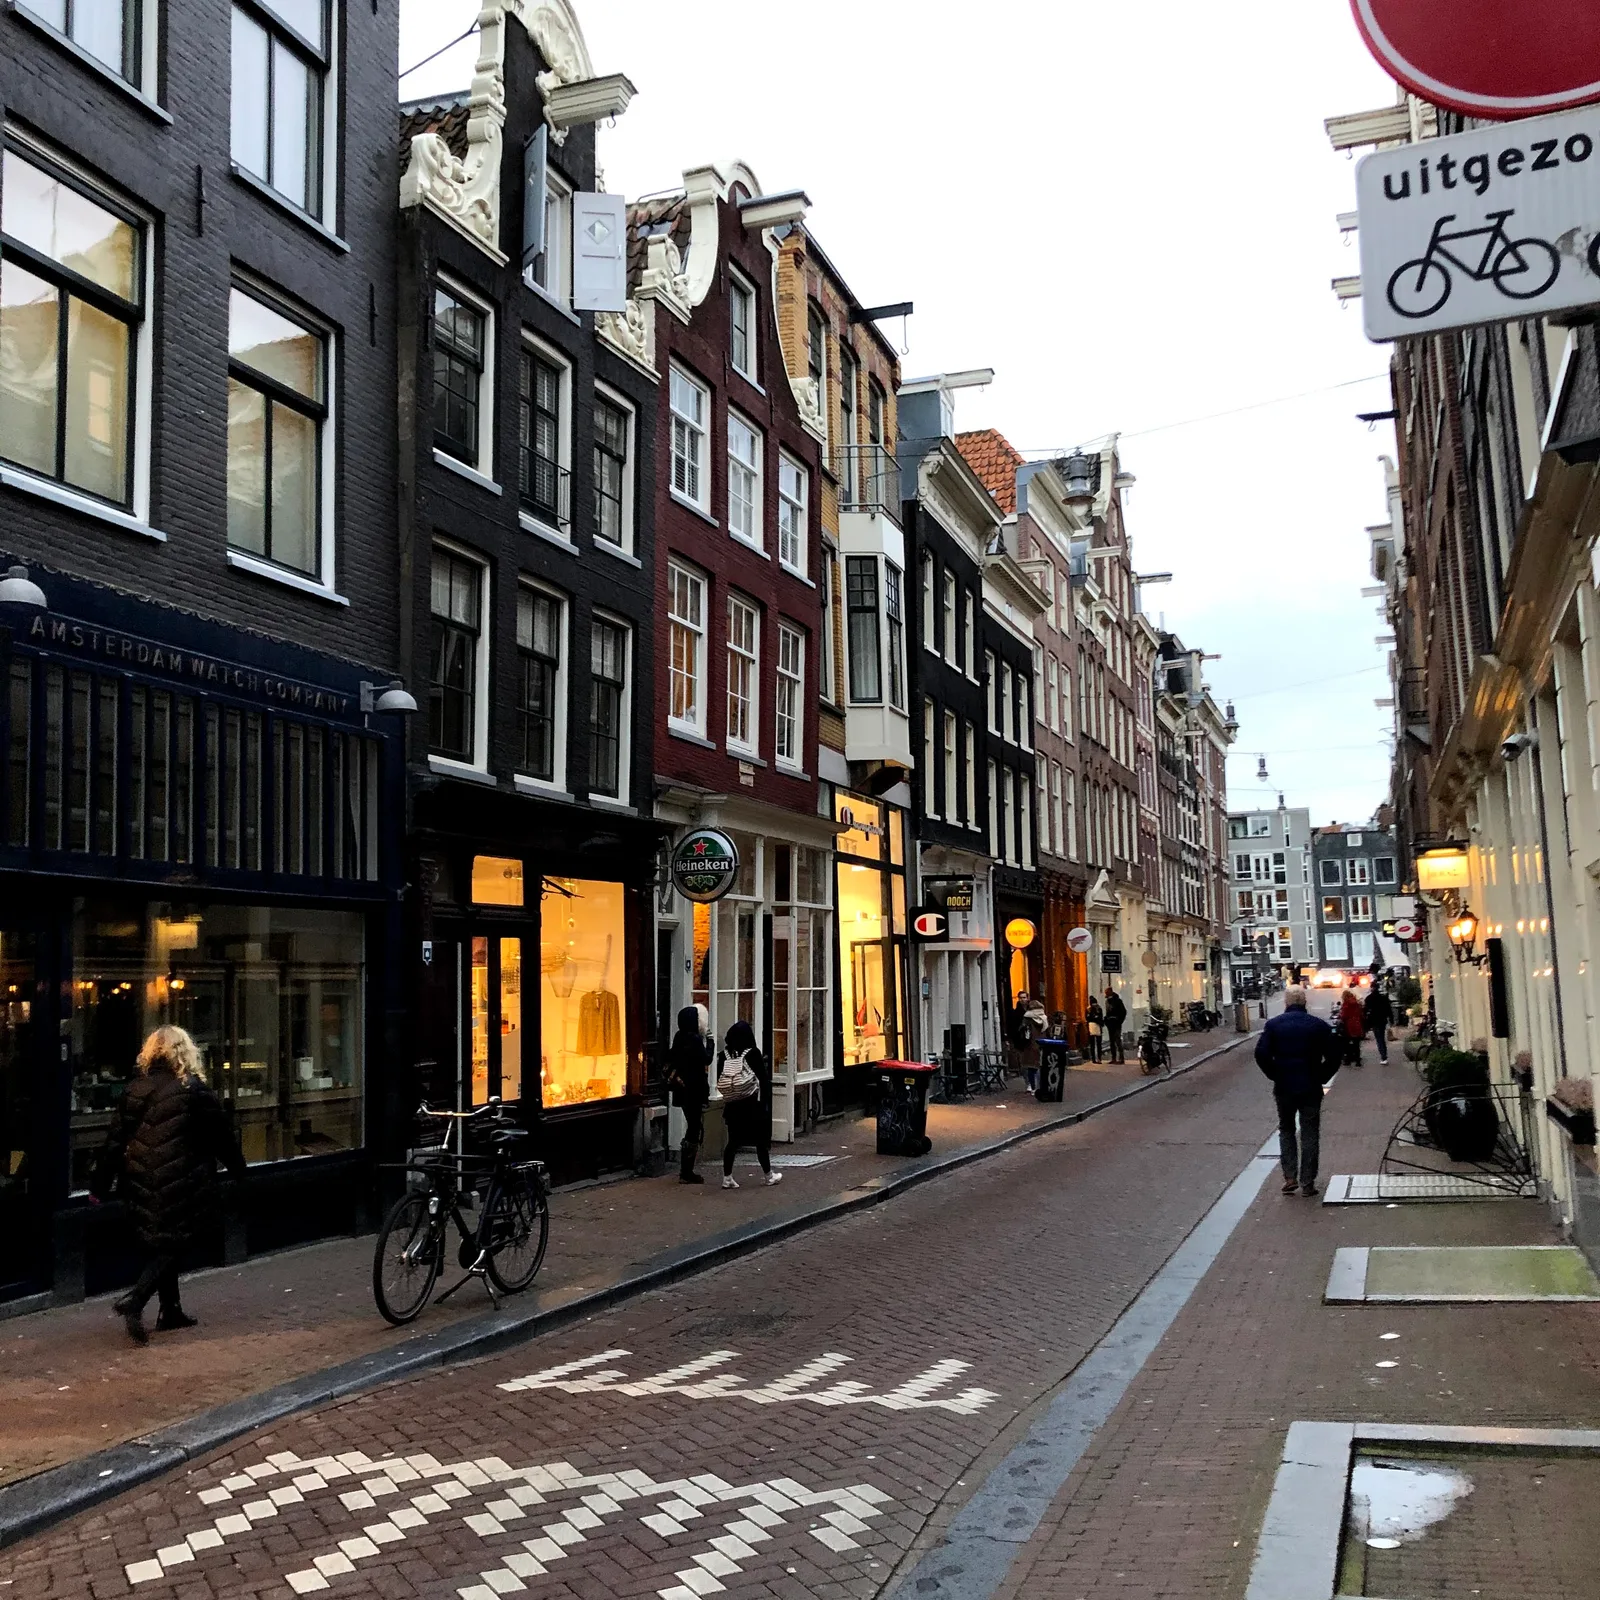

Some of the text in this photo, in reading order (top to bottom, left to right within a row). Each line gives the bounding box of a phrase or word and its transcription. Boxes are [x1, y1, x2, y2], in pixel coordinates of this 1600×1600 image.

[1384, 132, 1600, 200] uitgezo
[30, 615, 348, 713] AMSTERDAM WATCH COMPANY
[675, 859, 729, 872] Heineken
